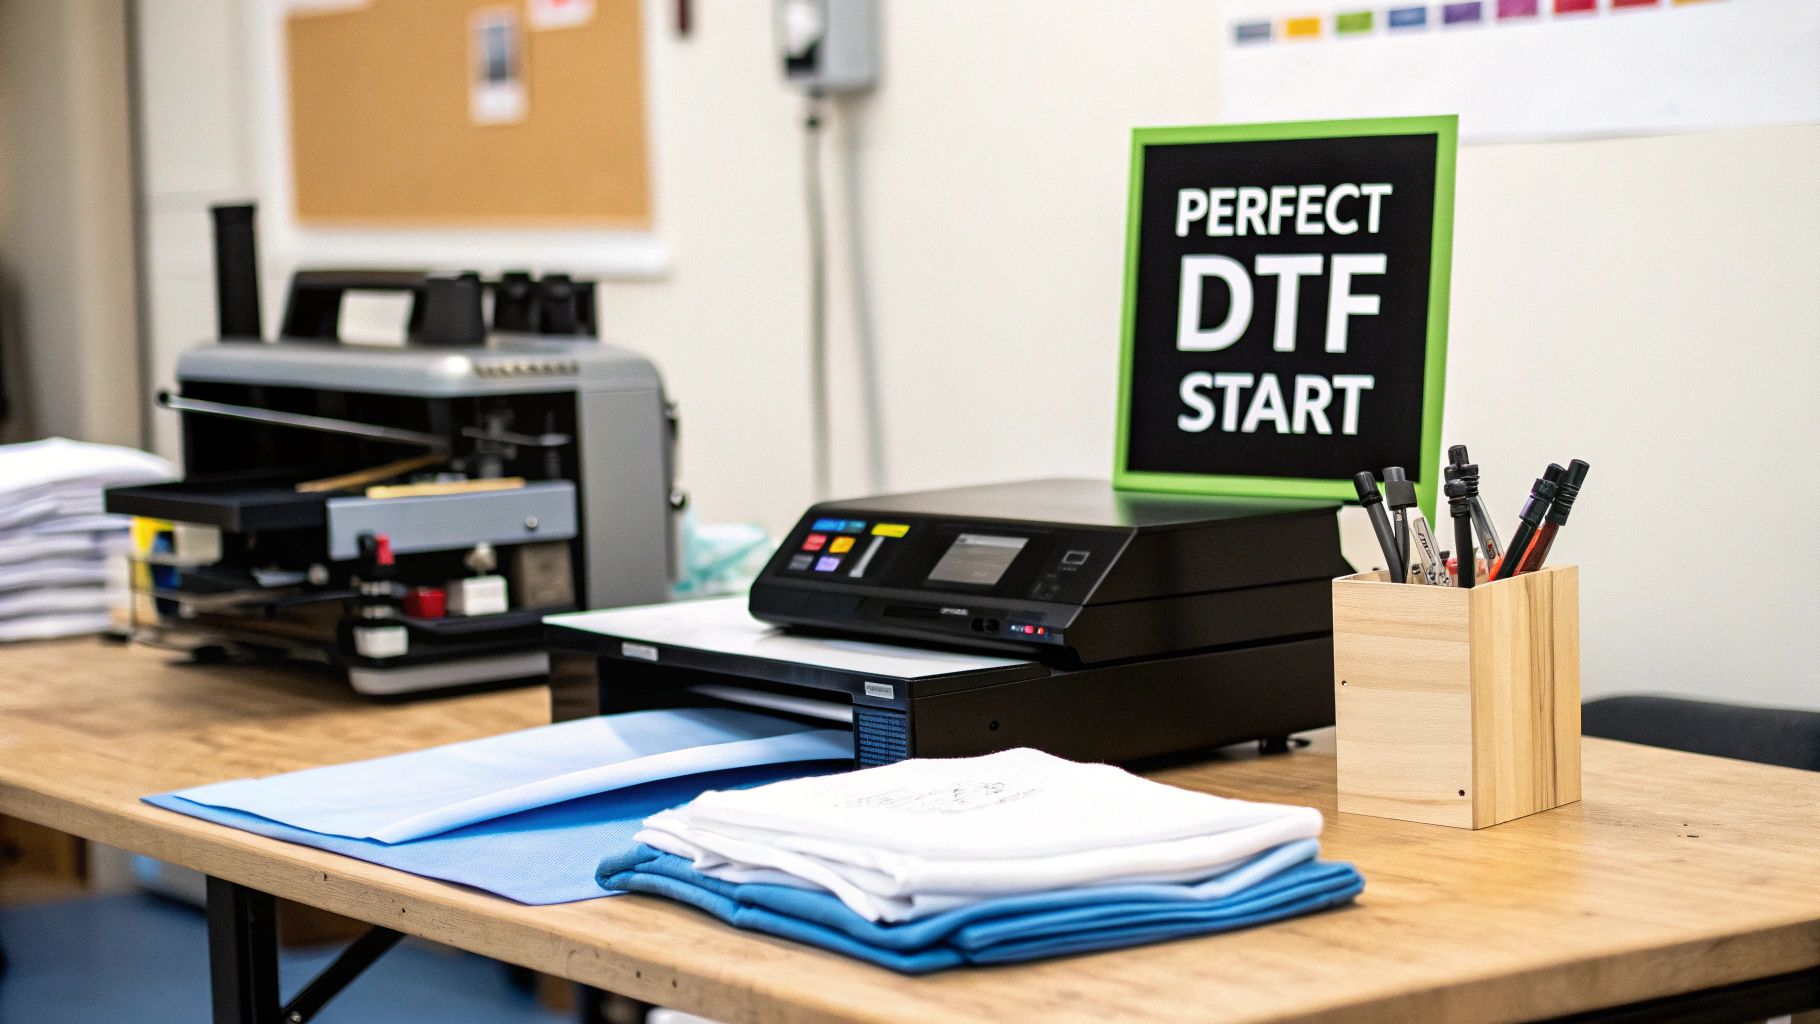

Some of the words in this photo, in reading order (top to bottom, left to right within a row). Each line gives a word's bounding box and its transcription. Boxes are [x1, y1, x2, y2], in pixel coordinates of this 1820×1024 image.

[1176, 184, 1393, 237] PERFECT
[1176, 253, 1388, 353] DTF
[1177, 372, 1375, 435] START
